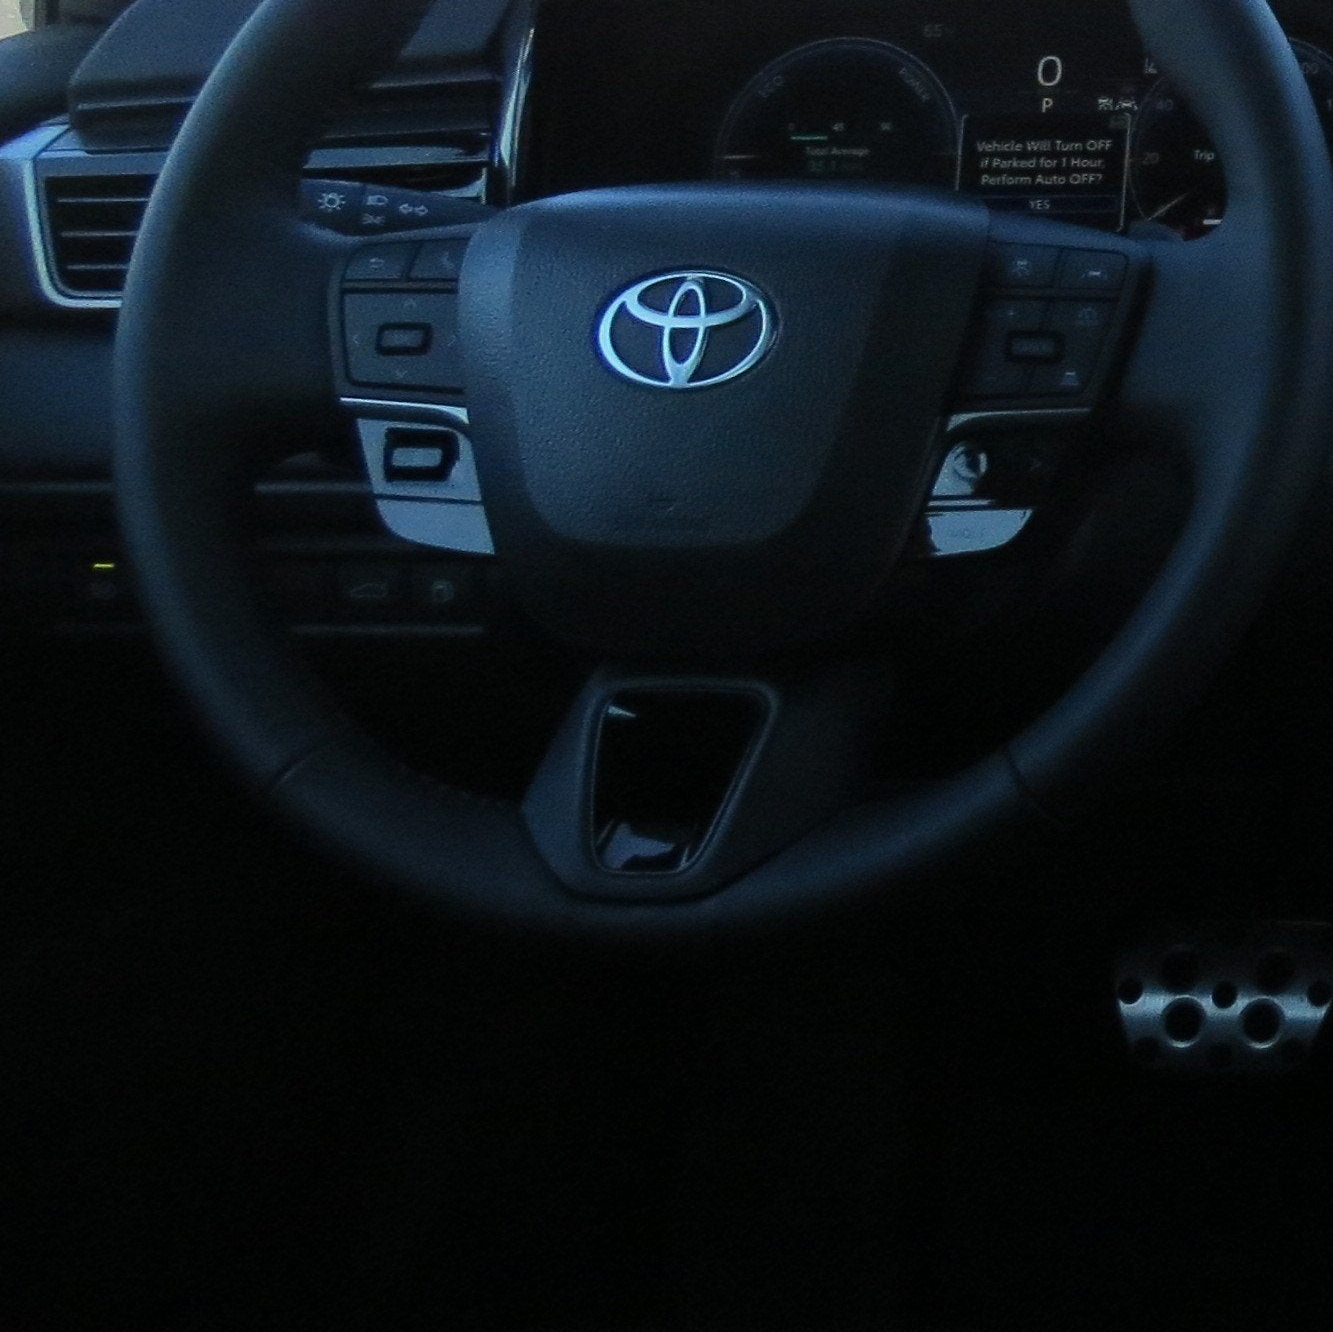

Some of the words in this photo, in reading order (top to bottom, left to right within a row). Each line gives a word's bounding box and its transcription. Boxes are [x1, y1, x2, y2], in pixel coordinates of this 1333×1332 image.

[1036, 54, 1063, 87] 0
[1041, 97, 1054, 113] P
[976, 140, 1023, 153] Vehicle
[1025, 140, 1051, 152] Will
[1055, 140, 1083, 152] Turn
[1086, 139, 1113, 151] OFF
[980, 157, 989, 169] if
[991, 157, 1037, 169] Parked
[1039, 157, 1058, 169] for
[1193, 149, 1215, 163] Trip
[980, 173, 1032, 186] Perform
[1034, 173, 1067, 185] Auto
[1069, 173, 1103, 185] OFF?
[1028, 199, 1051, 210] YES
